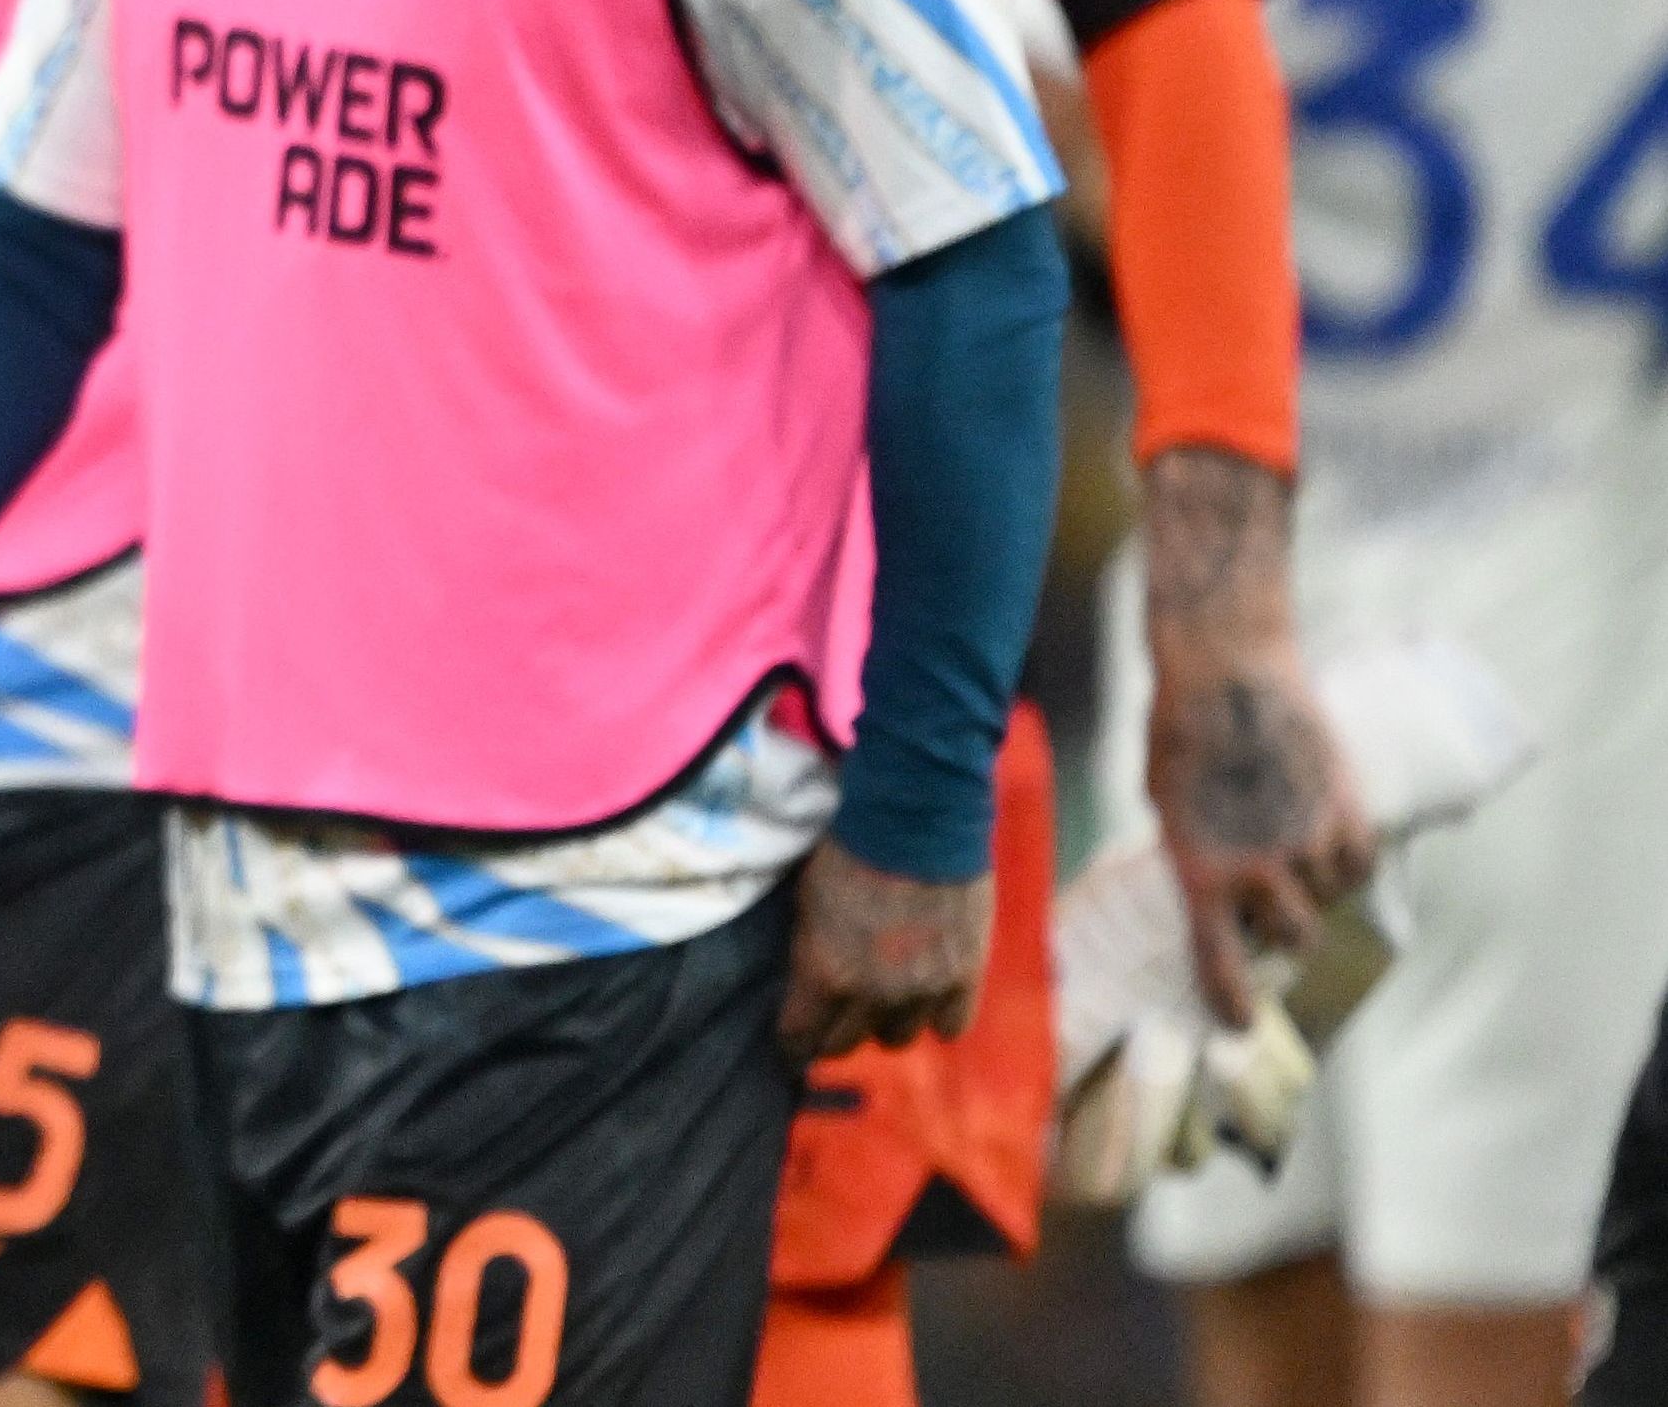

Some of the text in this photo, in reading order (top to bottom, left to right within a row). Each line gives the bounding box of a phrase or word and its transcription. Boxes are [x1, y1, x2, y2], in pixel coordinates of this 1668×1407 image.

[171, 16, 447, 160] POWER
[274, 143, 441, 259] ADE
[311, 1196, 569, 1407] 30
